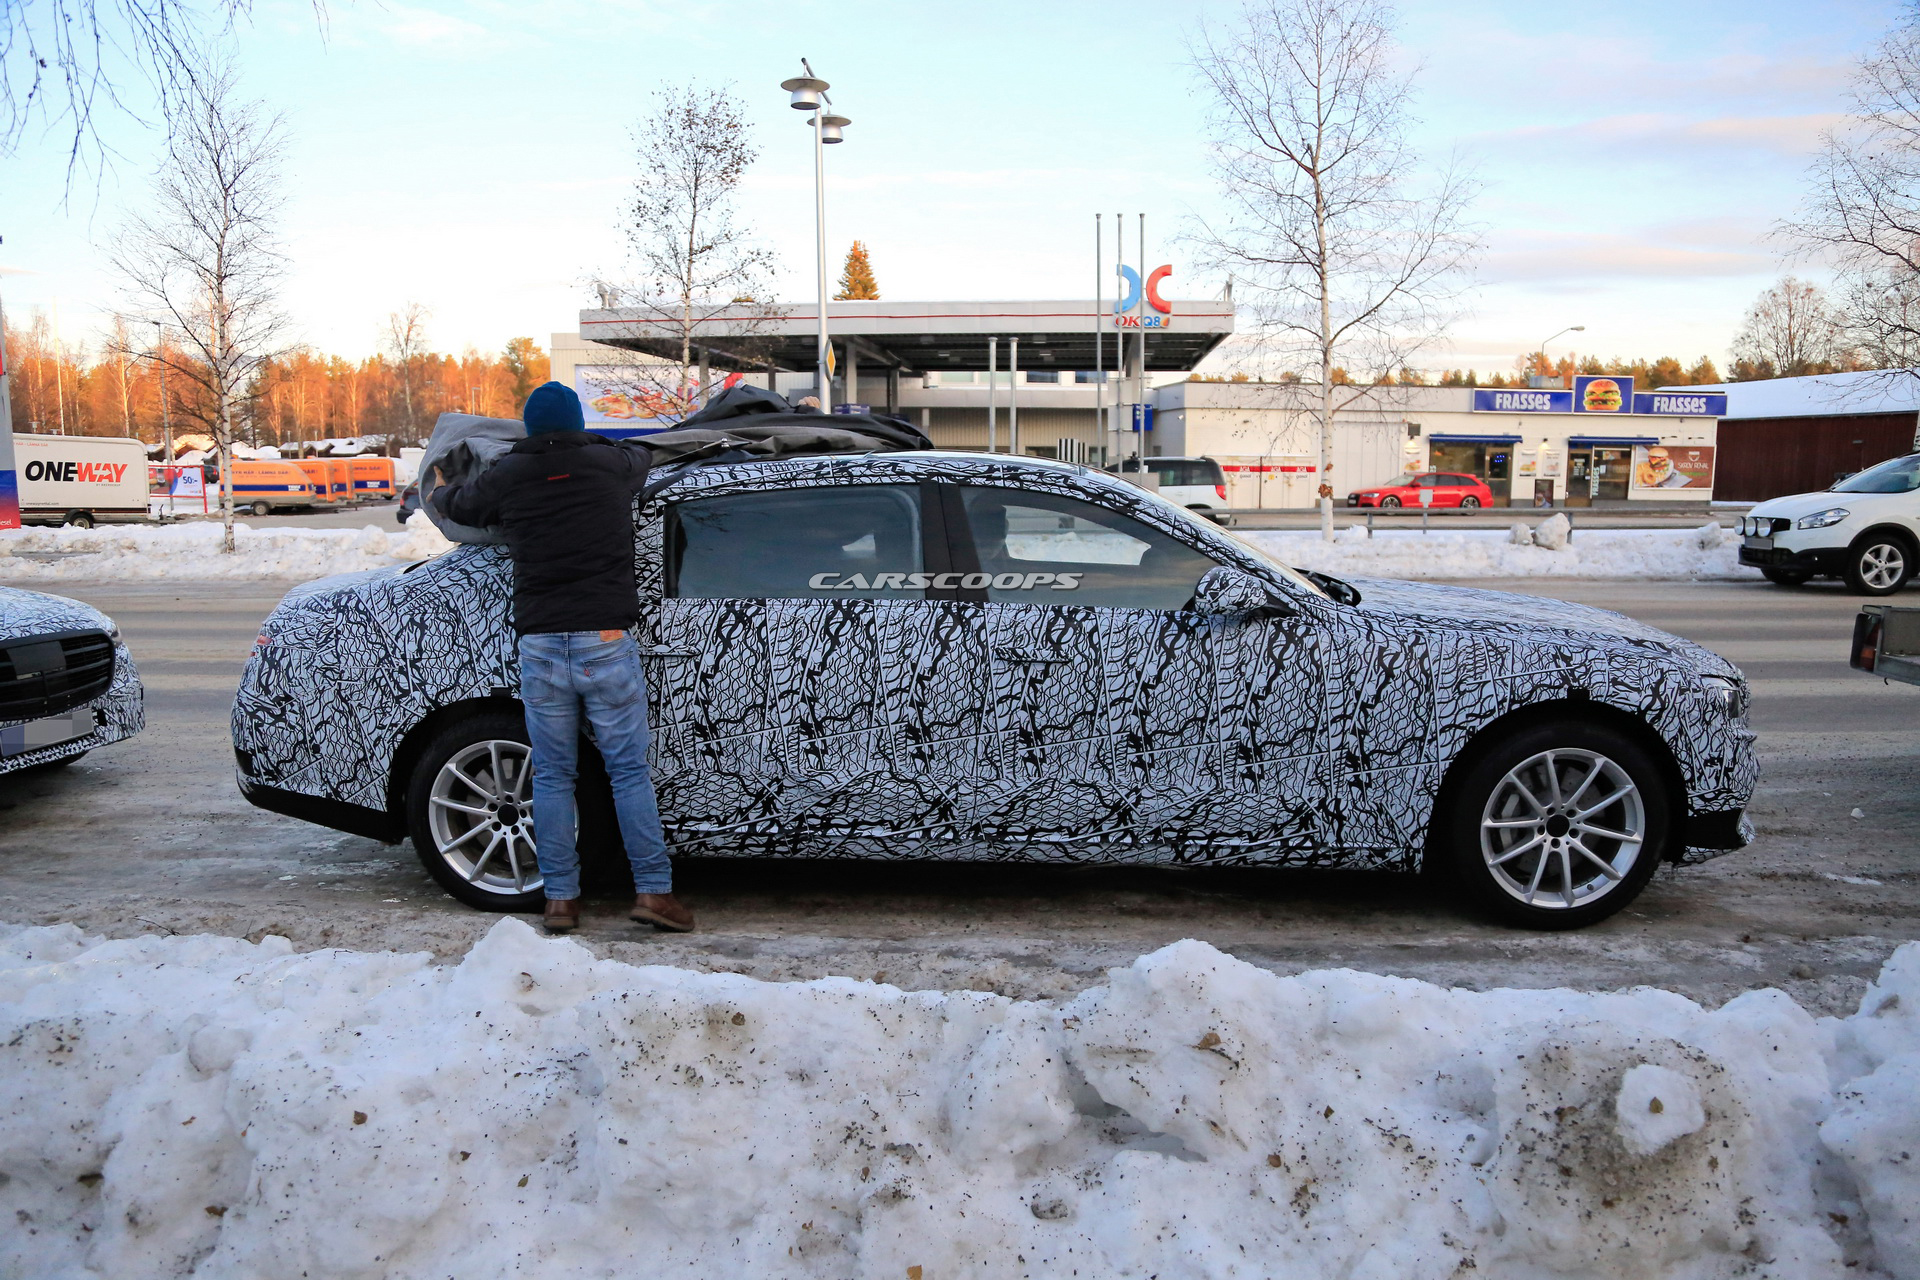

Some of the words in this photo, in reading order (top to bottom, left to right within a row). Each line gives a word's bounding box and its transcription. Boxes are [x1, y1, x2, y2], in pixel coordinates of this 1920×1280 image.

[1115, 315, 1161, 327] OKQ8
[1495, 393, 1551, 410] FRASSES
[1653, 397, 1707, 413] FRASSES
[25, 460, 128, 482] ONEWAY
